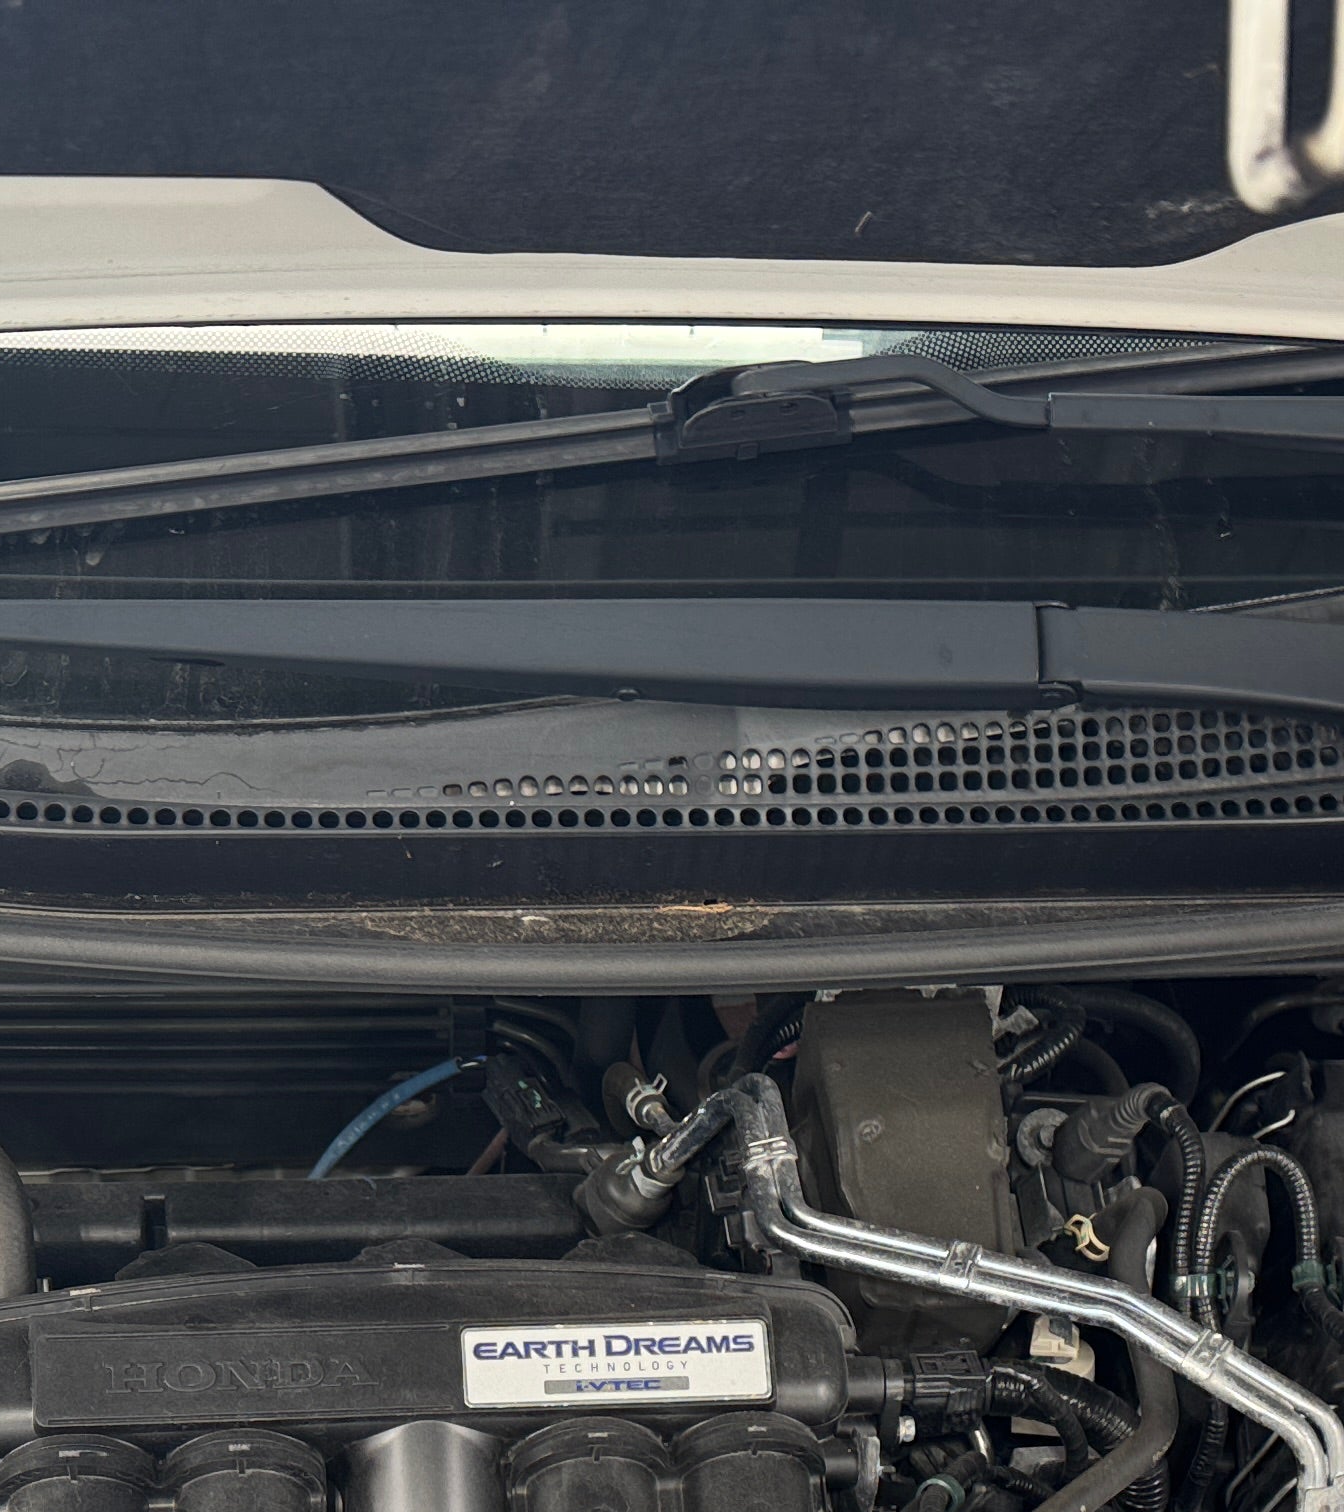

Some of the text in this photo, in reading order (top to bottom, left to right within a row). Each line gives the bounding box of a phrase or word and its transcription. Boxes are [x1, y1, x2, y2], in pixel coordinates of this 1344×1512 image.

[472, 1334, 755, 1361] EARTH DREAMS
[102, 1356, 380, 1394] HONDA
[544, 1359, 689, 1374] TECHNOLOGY
